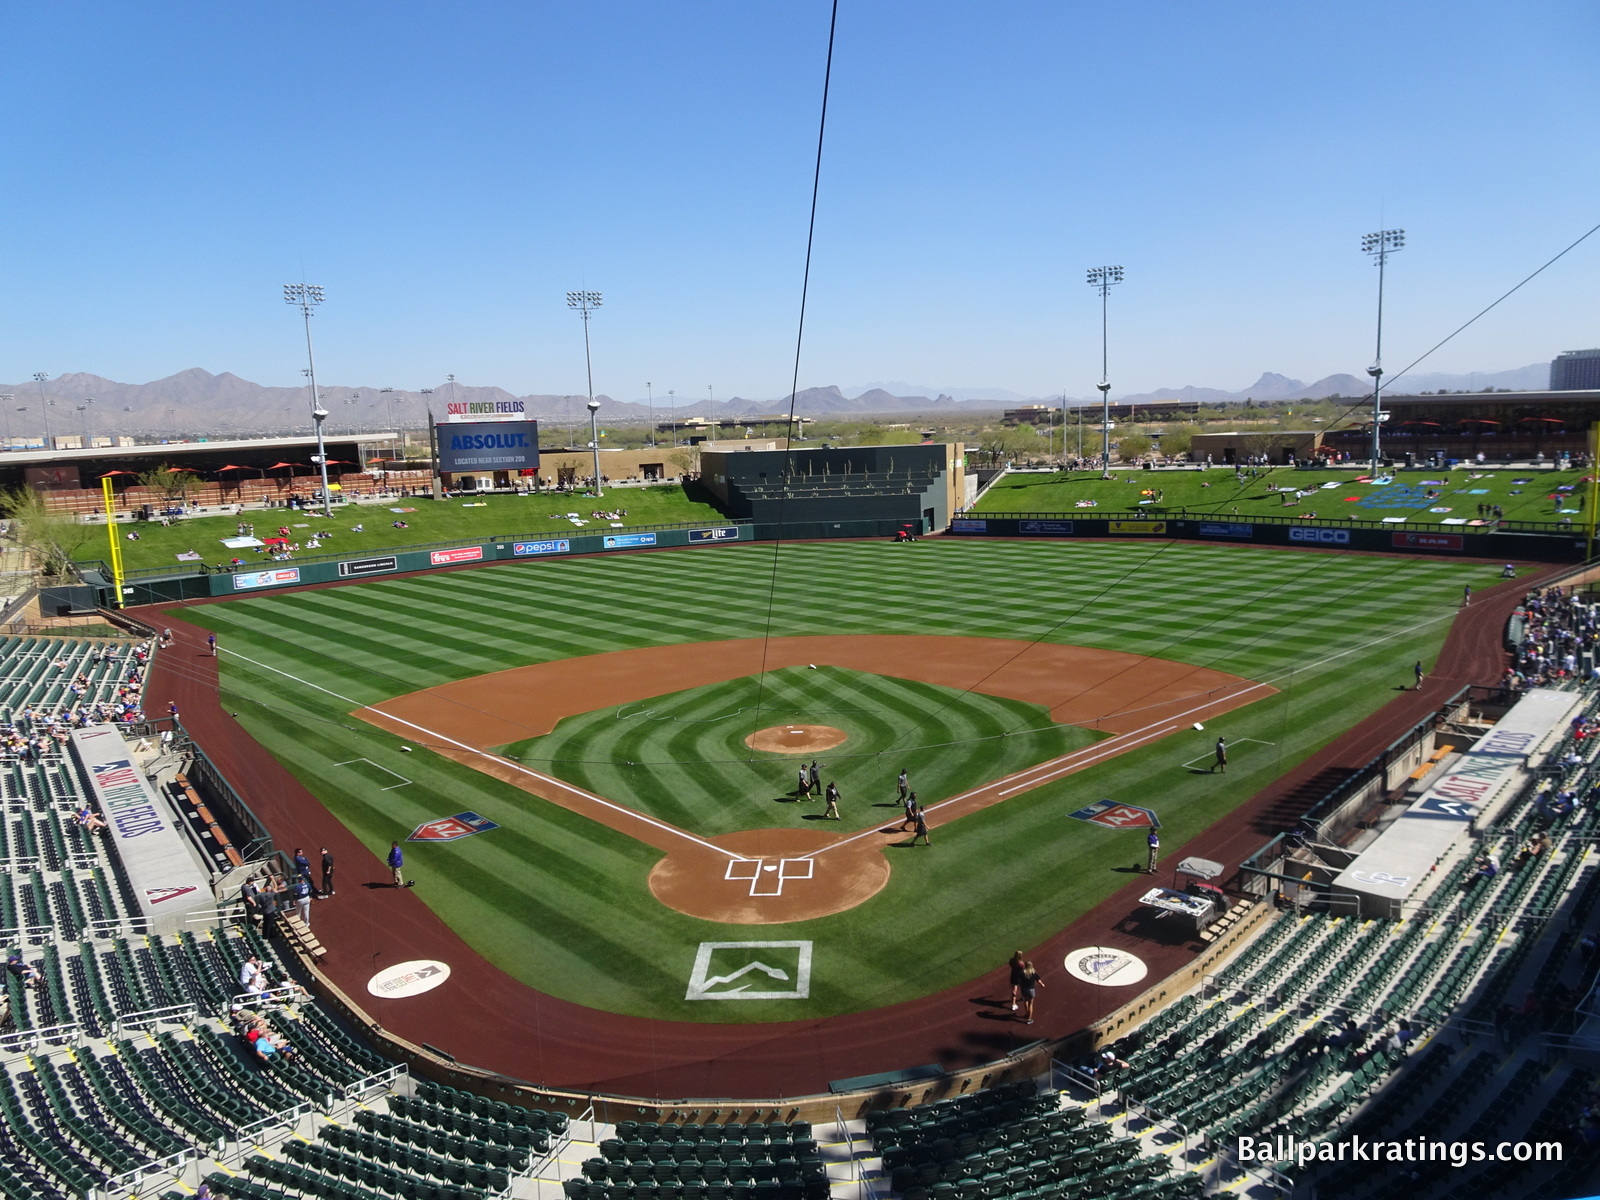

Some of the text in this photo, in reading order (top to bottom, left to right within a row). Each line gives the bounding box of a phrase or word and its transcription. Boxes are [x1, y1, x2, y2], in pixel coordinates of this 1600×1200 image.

[447, 401, 525, 414] SALT RIVER FIELDS
[493, 456, 515, 464] SECTION
[515, 455, 526, 463] 209
[711, 529, 727, 540] Lite
[1289, 527, 1350, 543] GEICO
[525, 541, 555, 554] pepsi
[1435, 730, 1536, 802] SALT RIVER FIELDS
[95, 768, 166, 839] SALT RIVER FIELDS
[1104, 808, 1143, 825] AZ
[427, 822, 467, 838] AZ
